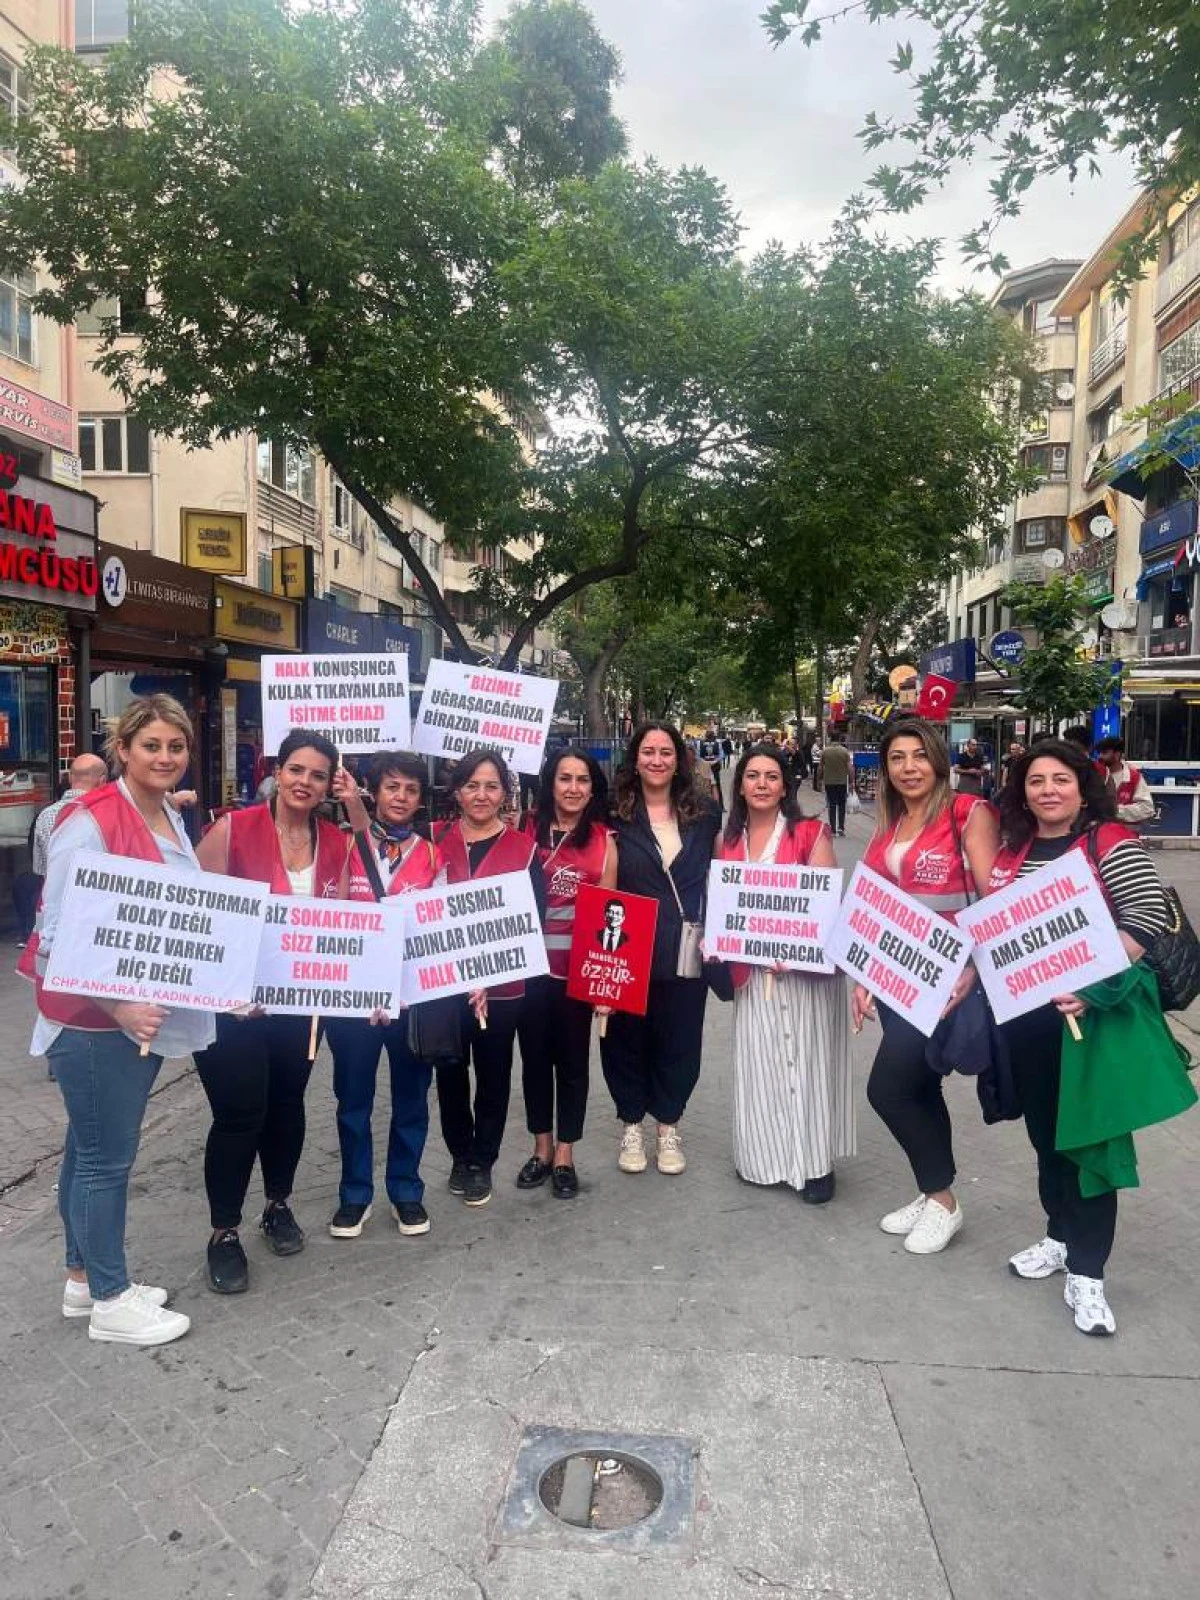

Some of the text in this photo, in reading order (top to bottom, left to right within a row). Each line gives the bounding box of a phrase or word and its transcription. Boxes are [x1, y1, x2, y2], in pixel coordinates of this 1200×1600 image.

[275, 660, 396, 680] HALK KONUŞUNCA
[268, 681, 406, 701] KULAK TIKAYANLARA
[431, 688, 544, 724] UĞRAŞACAĞINIZA
[290, 704, 385, 726] İŞİTME CİHAZI
[423, 708, 543, 745] BİRAZDA ADALETLE
[314, 726, 397, 745] RİYORUZ...
[75, 868, 262, 917] KADINLARI SUSTURMAK
[721, 866, 831, 892] SİZ KORKUN DİYE
[415, 885, 505, 925] CHP SUSMAZ
[737, 891, 809, 913] BURADAYIZ
[116, 902, 212, 936] KOLAY DEĞİL
[725, 913, 819, 939] BİZ SUSARSAK
[853, 874, 964, 964] DEMOKRASİ SİZE
[94, 926, 226, 963] HELE BİZ VARKEN
[280, 931, 364, 956] SİZZ HANGİ
[402, 912, 538, 961] ADINLAR KORKMAZ,
[716, 935, 825, 966] KİM KONUŞACAK
[849, 906, 944, 988] AĞIR GELDİYSE
[991, 906, 1090, 970] AMA SİZ HALA
[115, 956, 193, 987] HİÇ DEĞİL
[292, 961, 349, 982] EKRANI
[418, 946, 527, 991] HALK YENİLMEZ!
[846, 941, 921, 1010] BİZ TAŞIRIZ
[51, 976, 79, 988] CHP
[82, 981, 135, 998] ANKARA
[153, 988, 191, 1004] KADIN
[193, 995, 244, 1008] KOLLAR
[251, 985, 392, 1010] ARARTIYORSUNUZ
